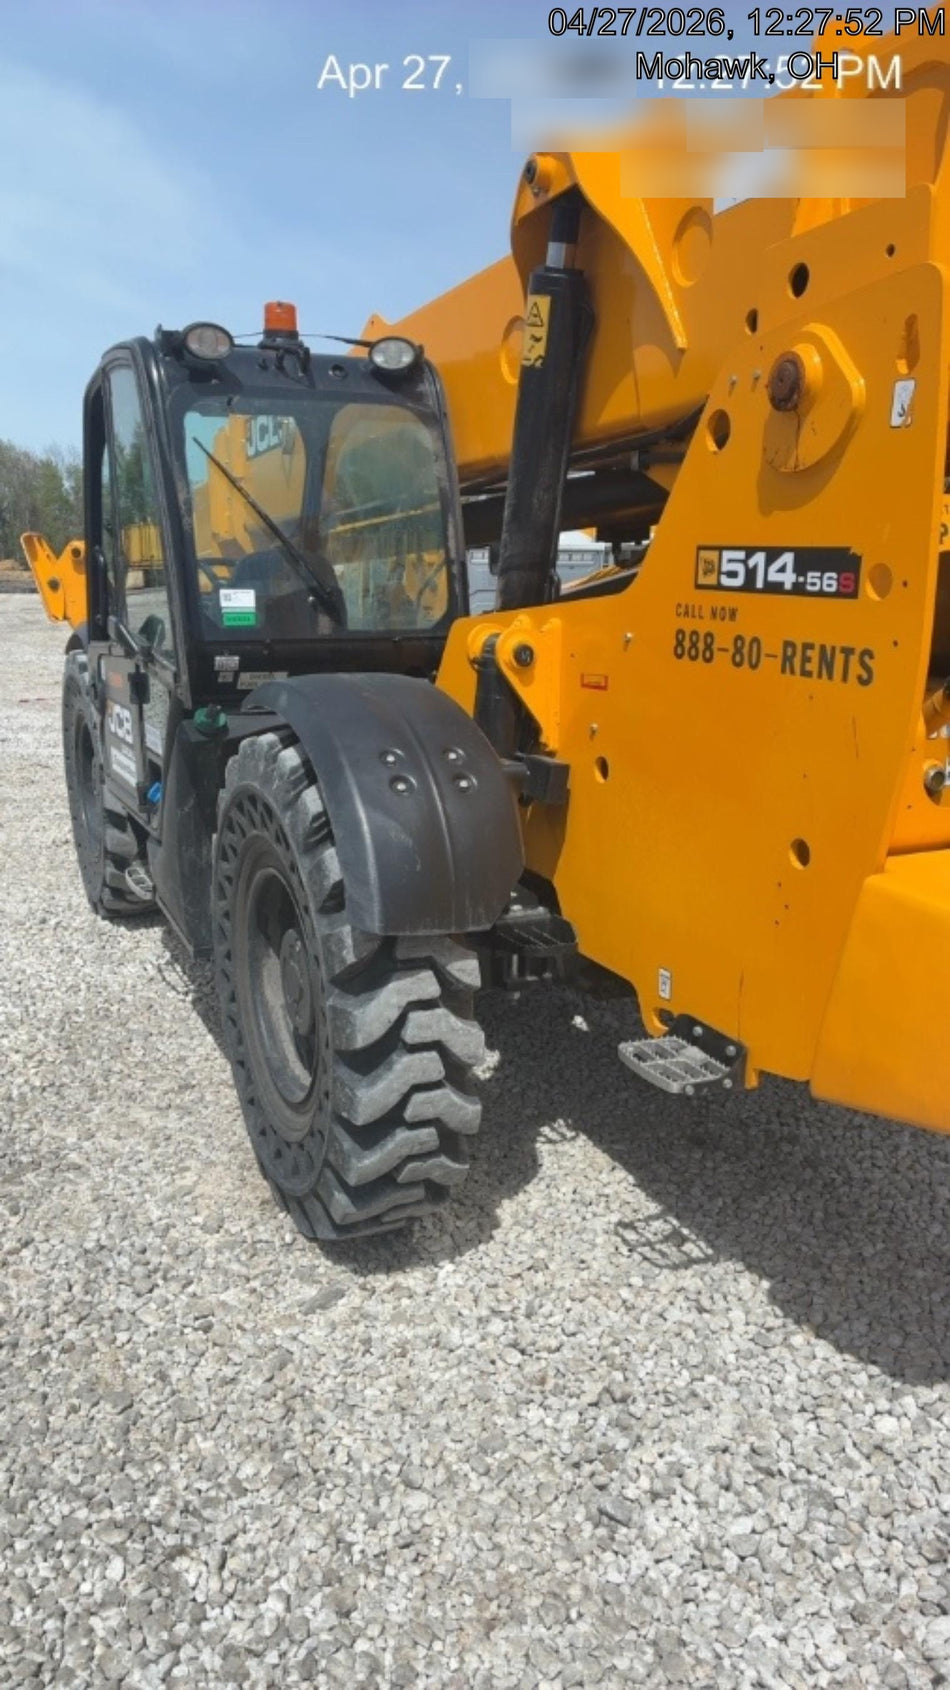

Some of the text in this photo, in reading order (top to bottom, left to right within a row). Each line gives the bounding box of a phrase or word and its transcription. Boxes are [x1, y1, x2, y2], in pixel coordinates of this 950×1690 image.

[675, 602, 739, 622] CALL NOW
[673, 628, 876, 687] 888-80-RENTS
